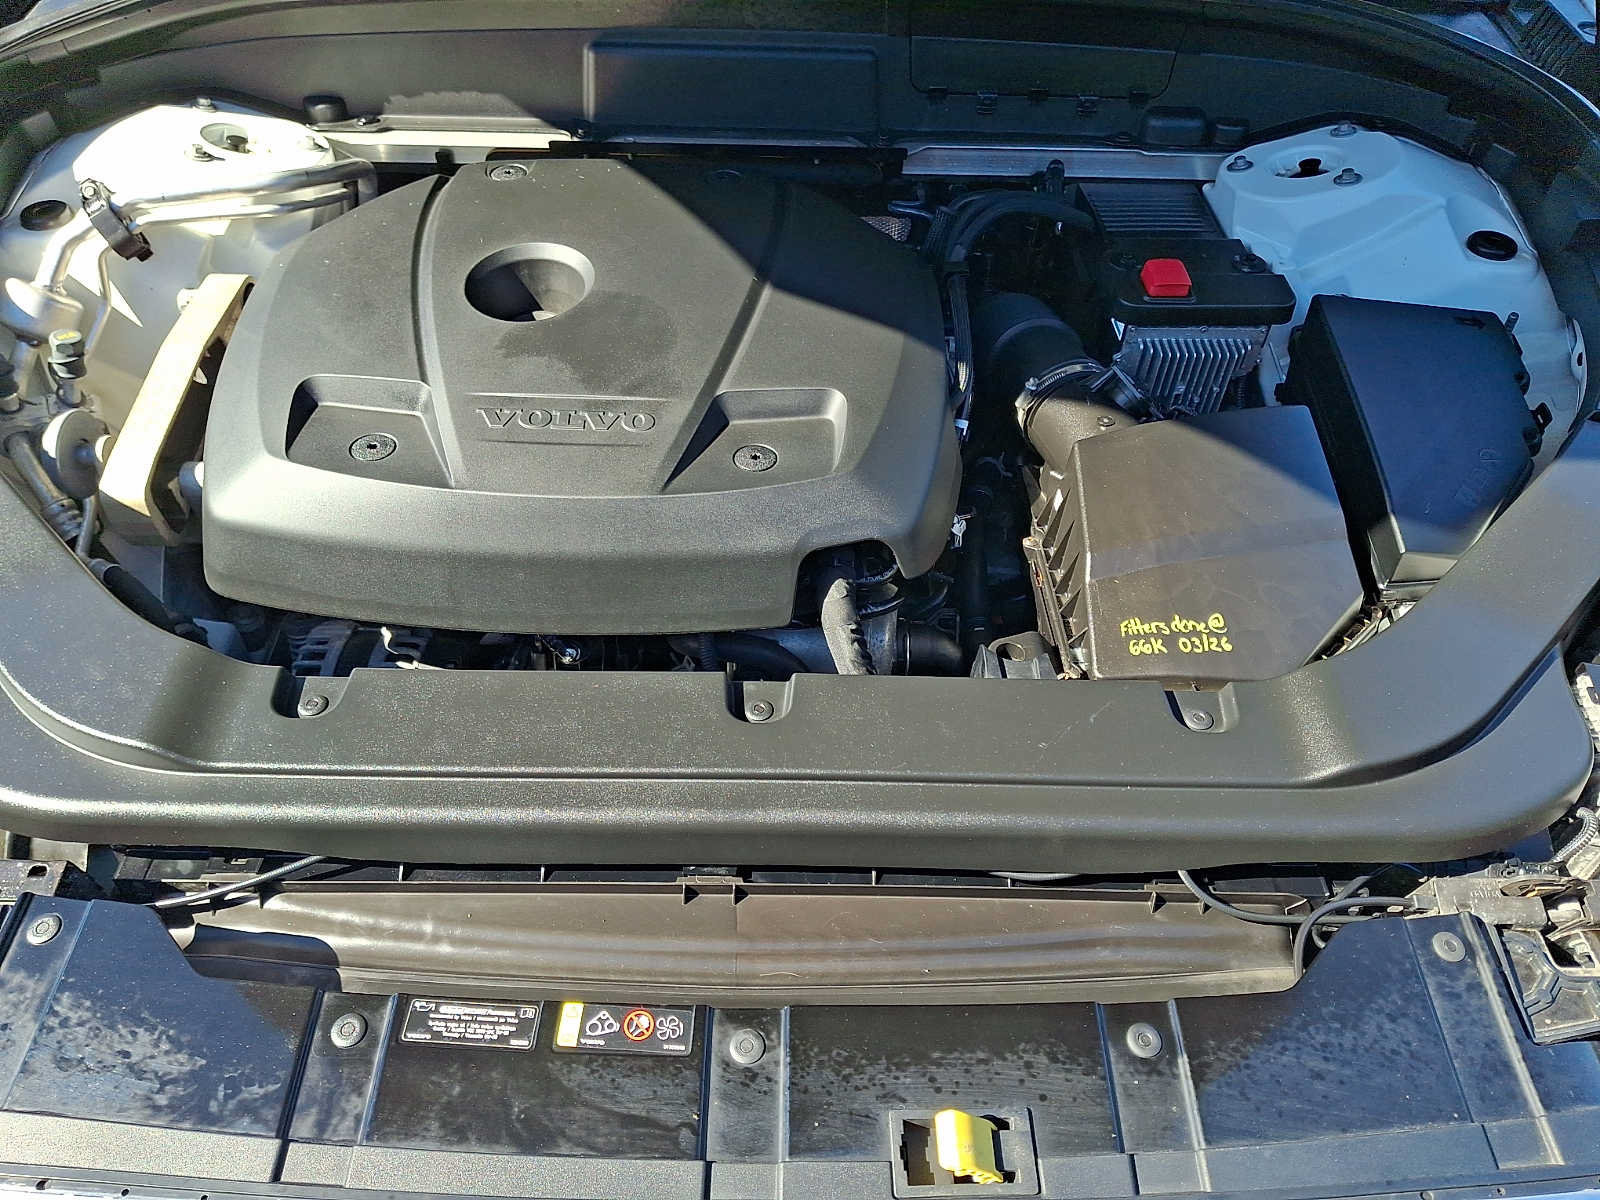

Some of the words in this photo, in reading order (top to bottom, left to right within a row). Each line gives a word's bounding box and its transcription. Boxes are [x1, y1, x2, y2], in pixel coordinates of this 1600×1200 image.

[476, 407, 656, 432] VOLVO
[1120, 617, 1170, 637] Filters
[1178, 633, 1233, 654] 03/26
